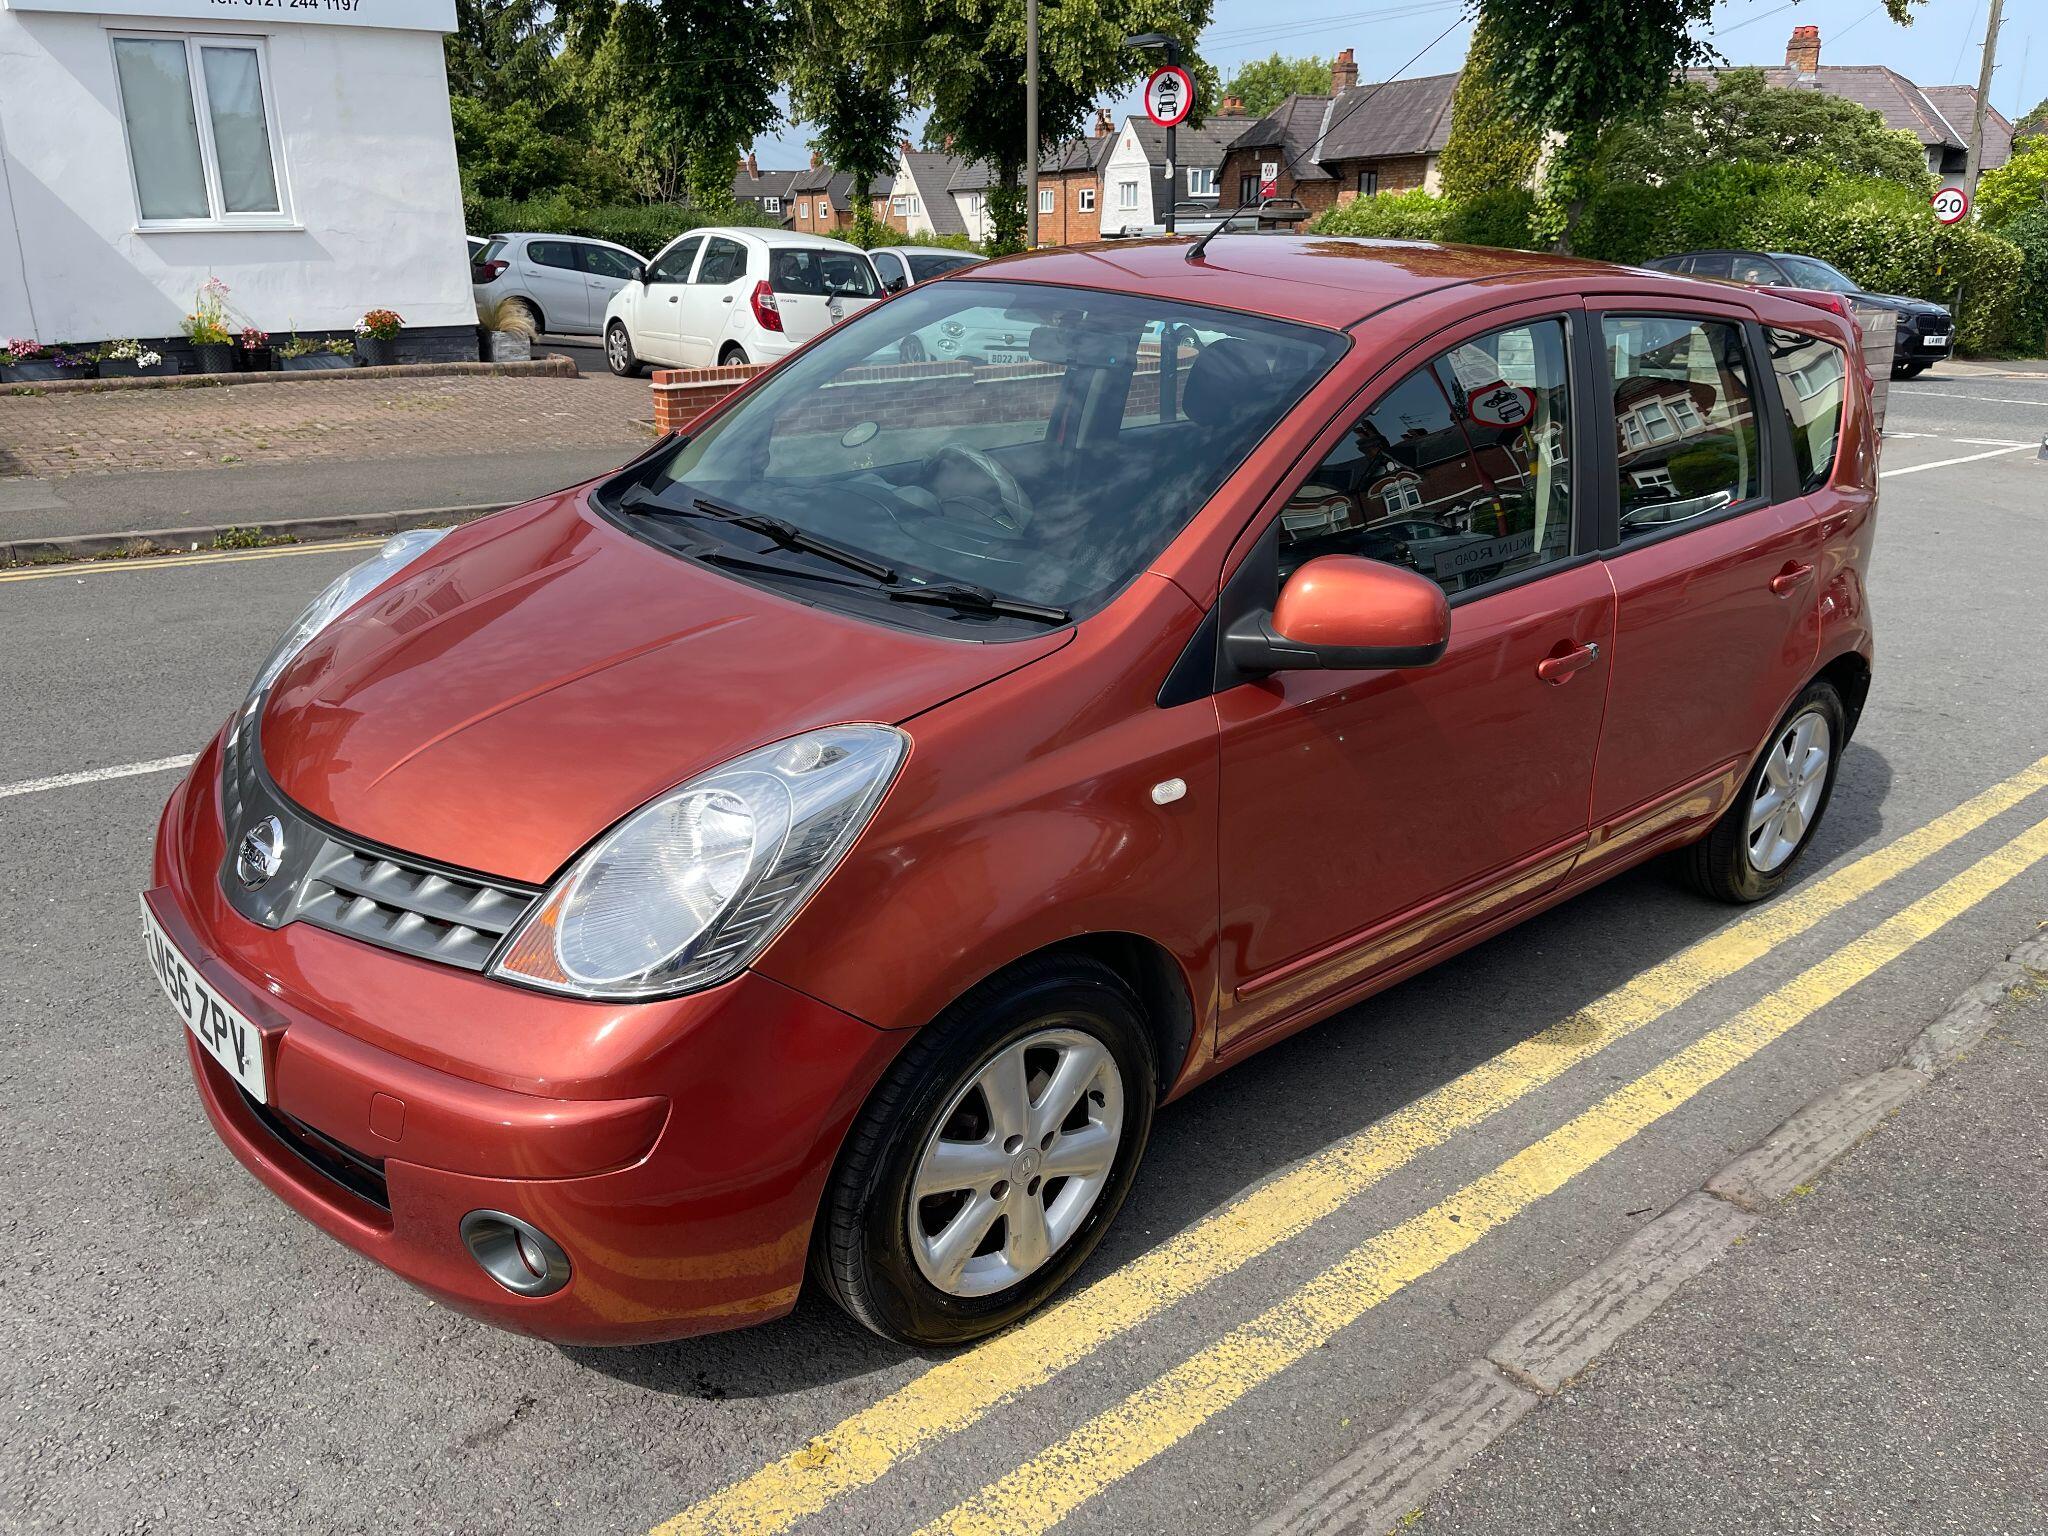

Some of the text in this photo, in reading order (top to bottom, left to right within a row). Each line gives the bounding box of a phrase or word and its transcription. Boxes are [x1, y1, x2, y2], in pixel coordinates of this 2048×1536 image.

[324, 0, 359, 11] 1197
[1937, 198, 1962, 213] 20
[194, 981, 245, 1077] ZPV
